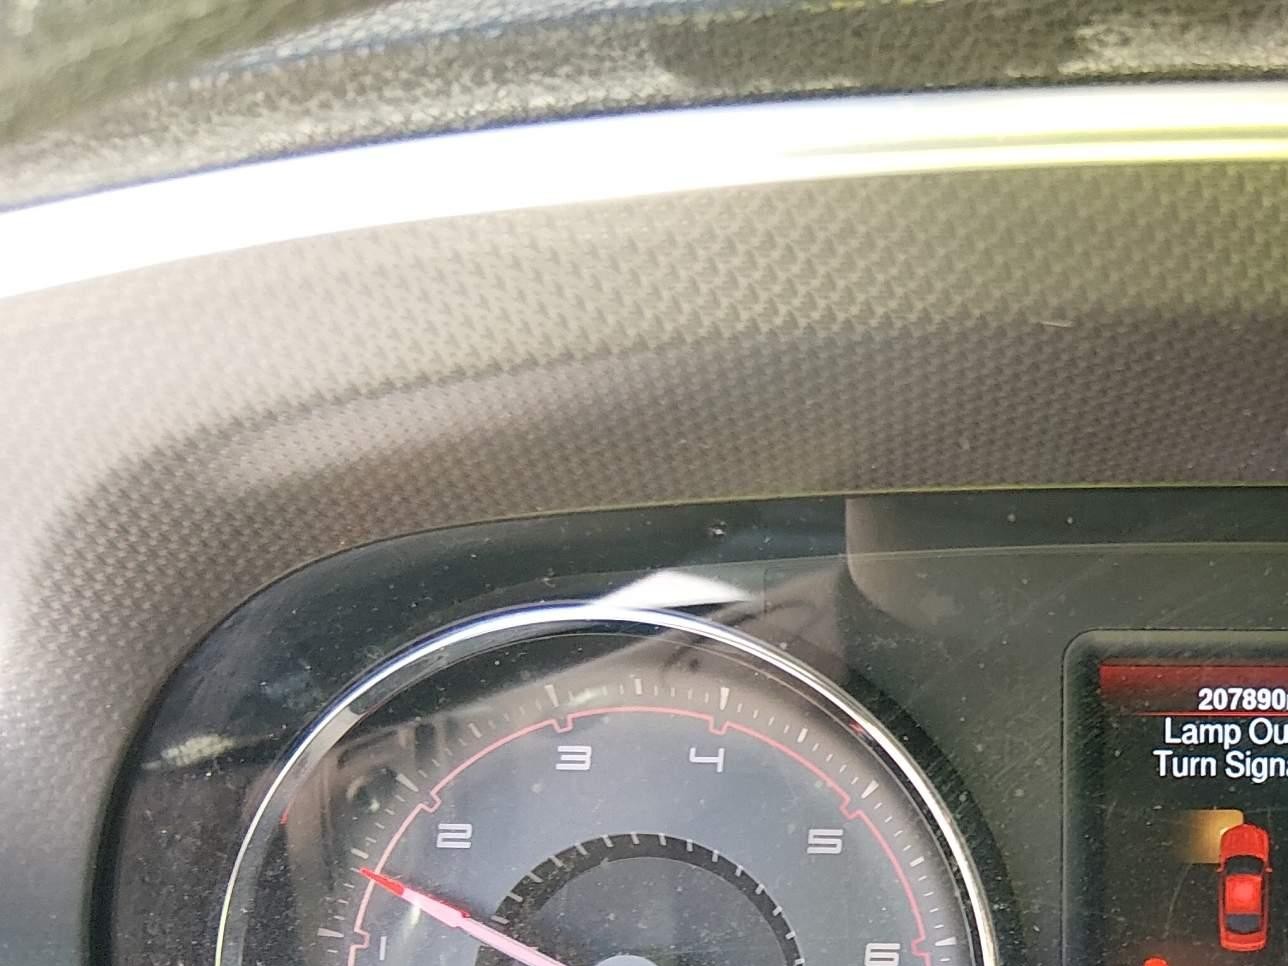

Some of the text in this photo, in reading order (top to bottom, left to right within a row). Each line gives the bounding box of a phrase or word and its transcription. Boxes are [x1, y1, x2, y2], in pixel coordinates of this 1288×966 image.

[1164, 718, 1242, 747] Lamp
[556, 745, 592, 772] 3
[688, 747, 725, 773] 4
[1153, 751, 1217, 777] Turn
[436, 823, 473, 849] 2
[806, 828, 844, 855] 5
